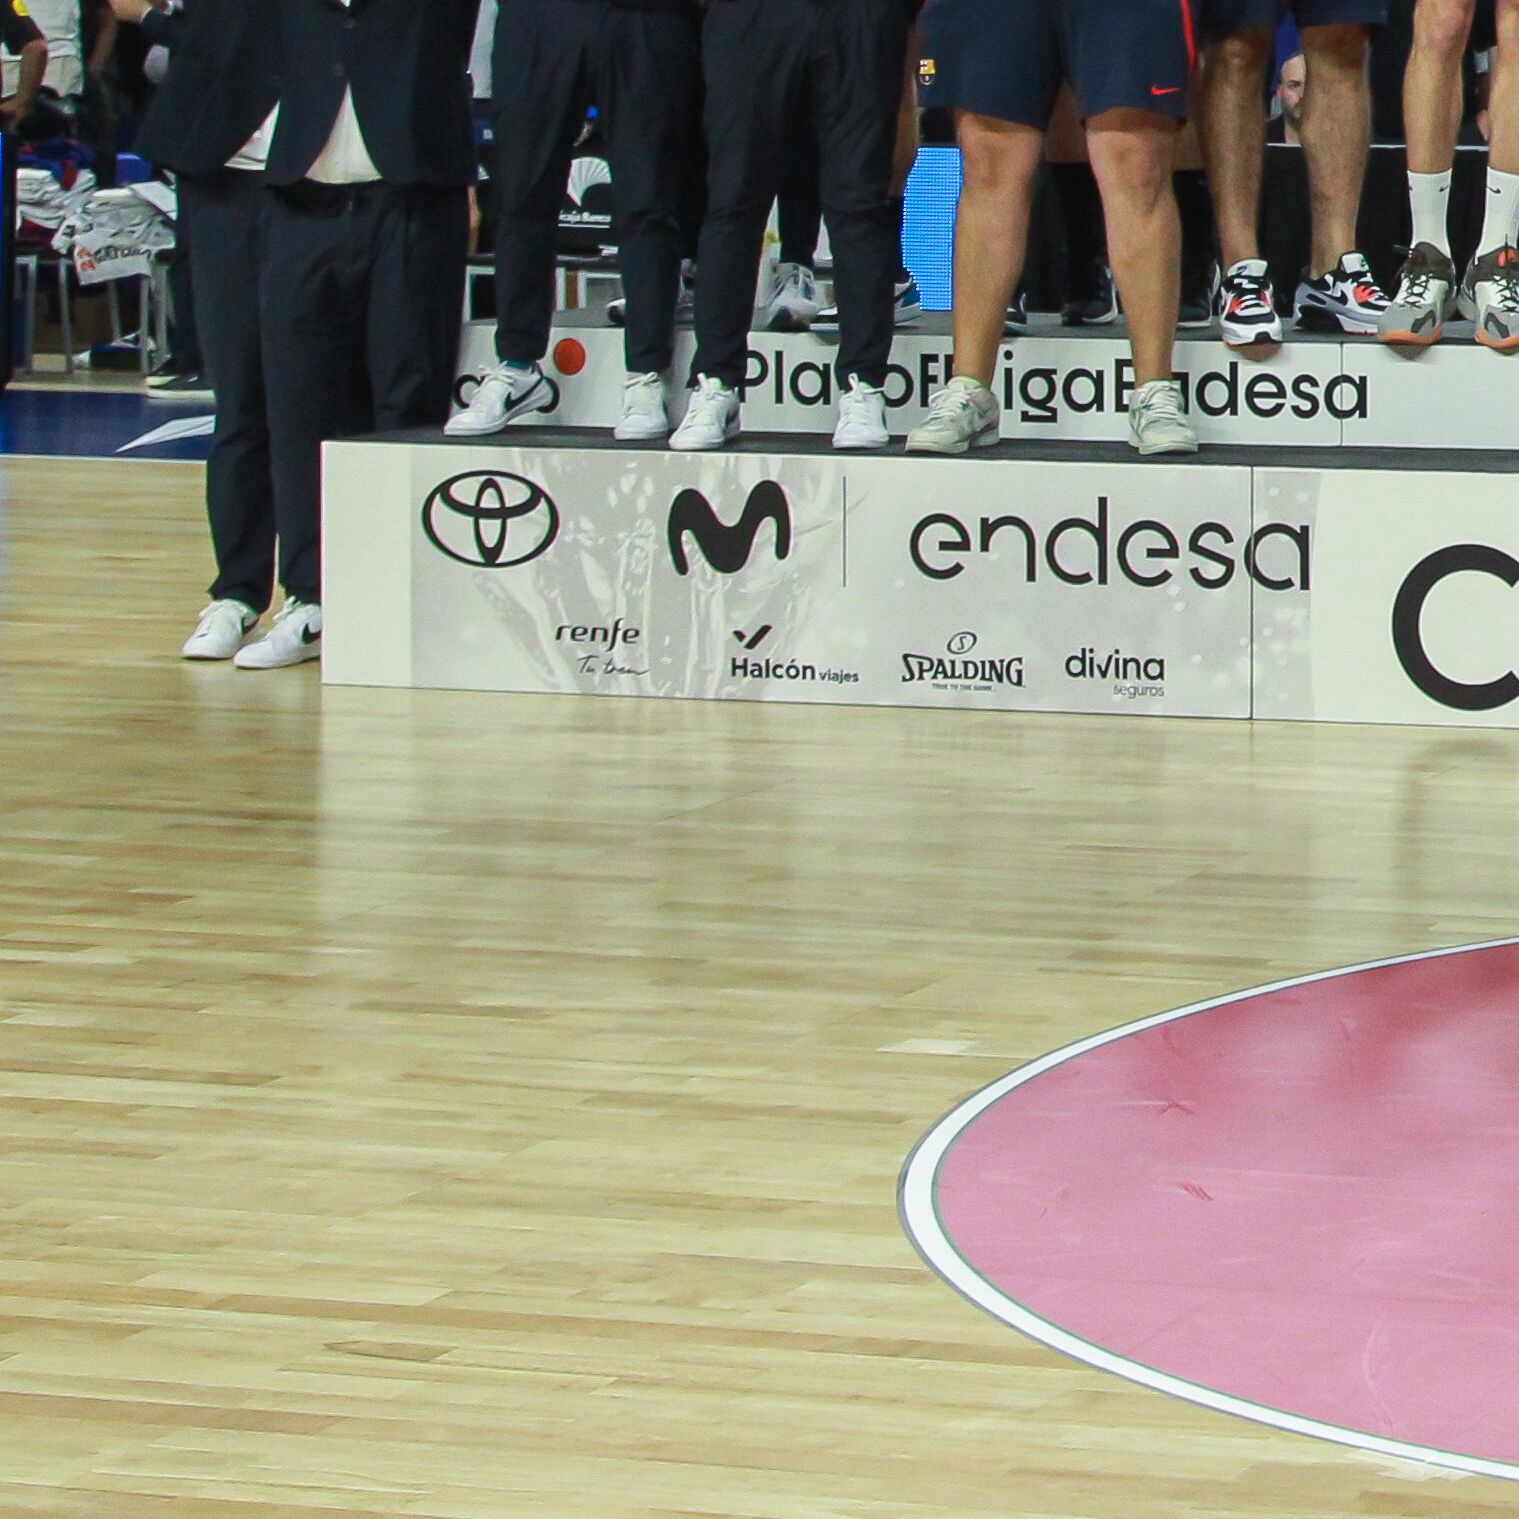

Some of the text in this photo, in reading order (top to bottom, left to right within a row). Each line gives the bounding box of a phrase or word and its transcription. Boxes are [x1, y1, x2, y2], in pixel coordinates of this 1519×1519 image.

[909, 496, 1311, 591] endesa
[555, 617, 640, 652] renfe
[731, 657, 860, 684] Halcón viajes
[902, 653, 1025, 689] SPALDING
[1065, 647, 1165, 681] divina
[1113, 684, 1164, 699] seguros
